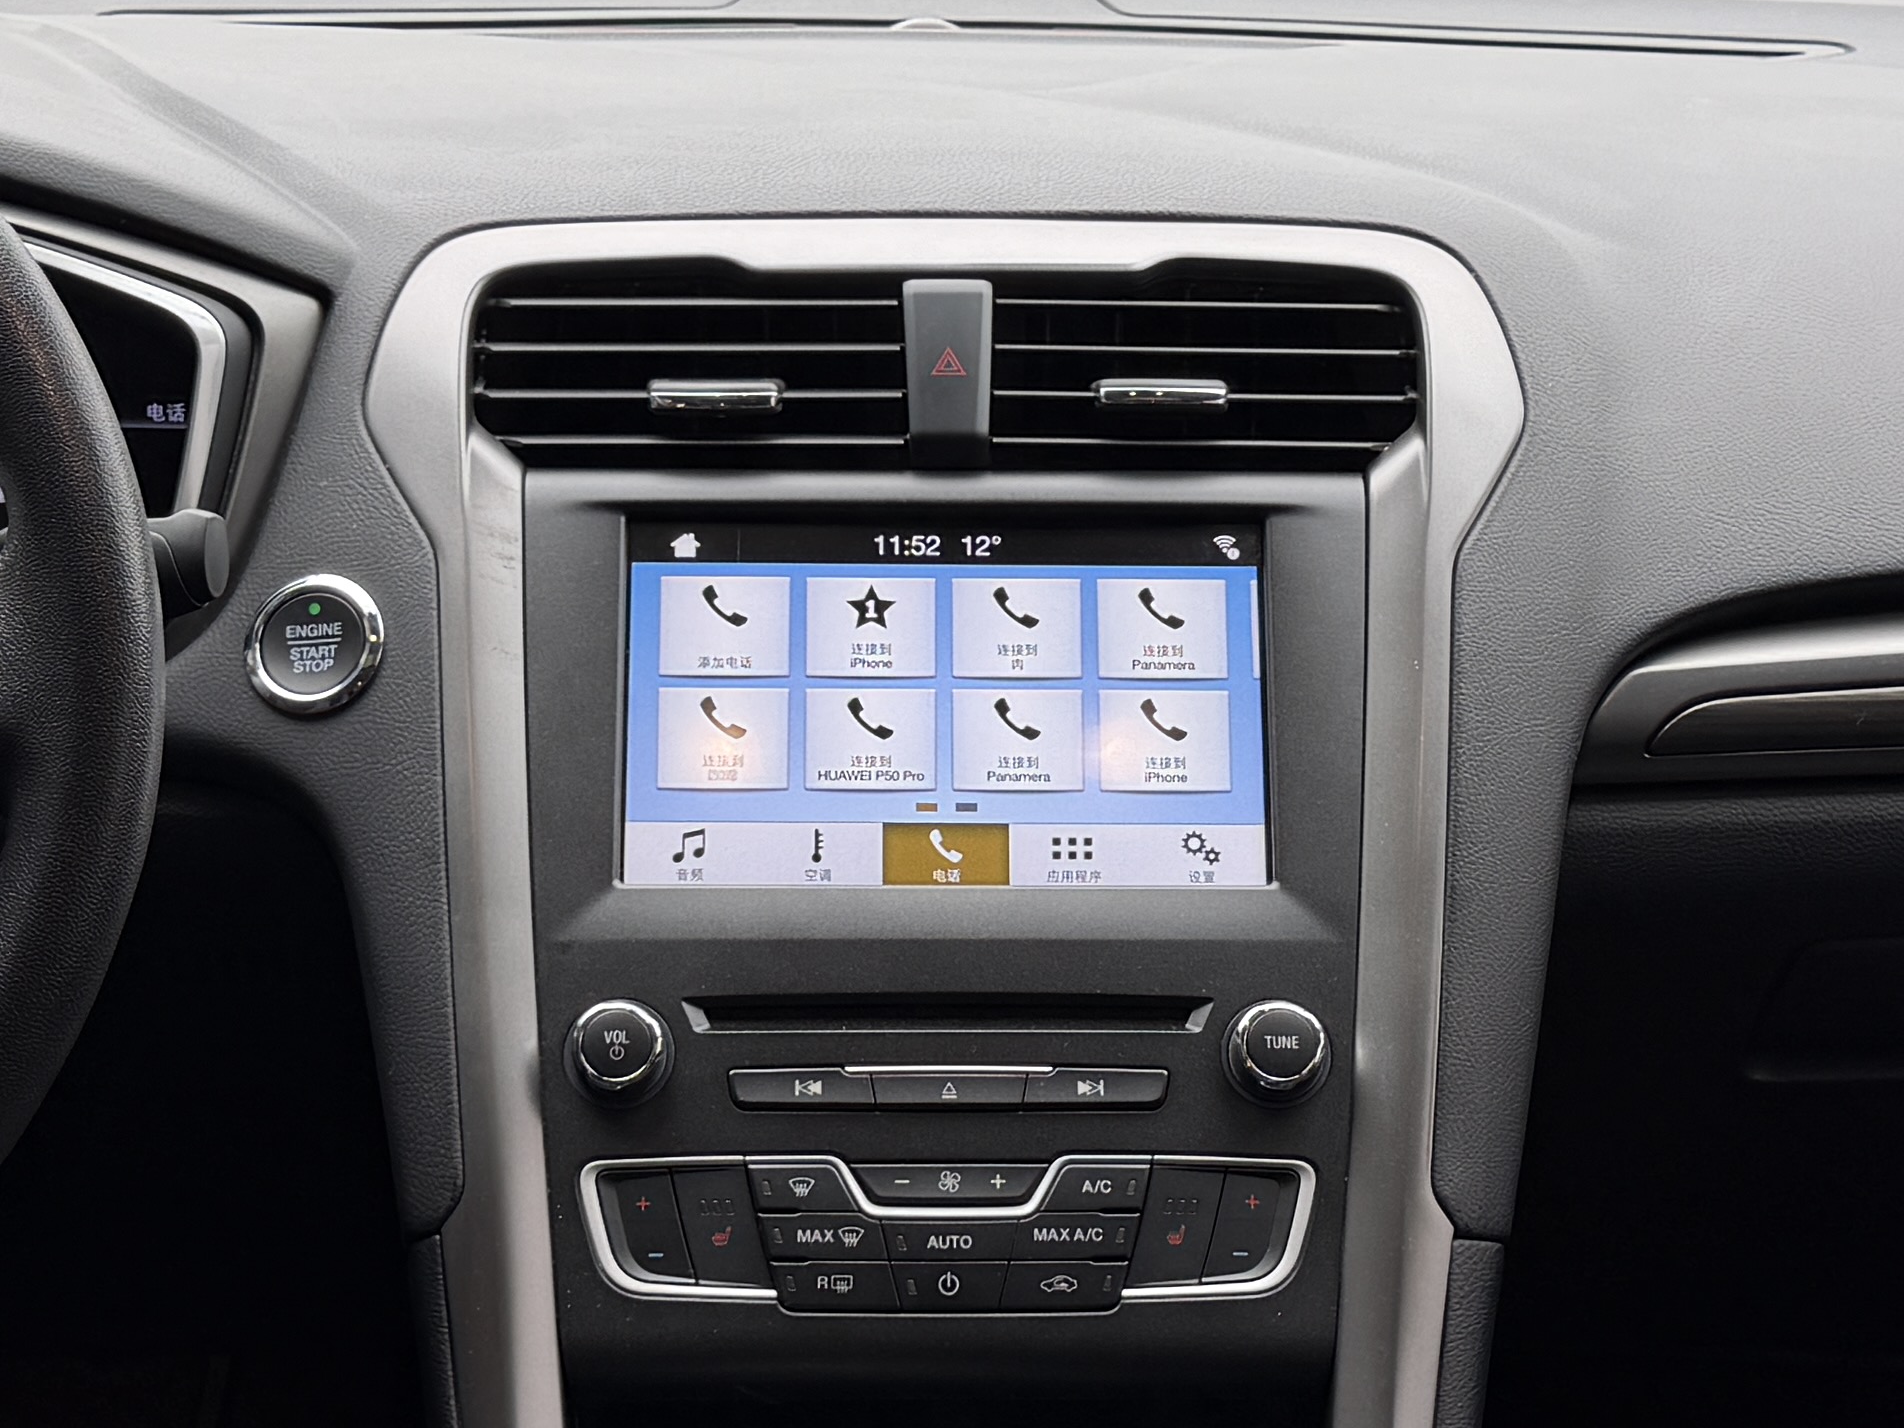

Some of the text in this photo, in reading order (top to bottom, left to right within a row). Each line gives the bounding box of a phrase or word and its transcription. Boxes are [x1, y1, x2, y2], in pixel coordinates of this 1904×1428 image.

[147, 402, 187, 423] 电话
[873, 534, 1003, 558] 11:52 12°
[285, 621, 343, 640] ENGINE
[289, 644, 339, 661] START
[850, 642, 893, 657] 连接到
[997, 643, 1039, 658] 连接到
[1142, 644, 1184, 659] 连接到
[292, 656, 335, 674] STOP
[697, 655, 753, 670] 添加电话
[849, 657, 893, 670] iPhone
[1131, 659, 1196, 672] Panamera
[850, 754, 893, 769] 连接到
[997, 755, 1040, 770] 连接到
[1144, 755, 1186, 770] 连接到
[817, 770, 925, 783] HUAWEI P50 Pro
[986, 770, 1051, 784] Panamera
[1143, 770, 1188, 784] iPhone
[676, 868, 704, 883] 音频
[804, 868, 832, 883] 空调
[933, 868, 961, 883] 电话
[1046, 869, 1102, 884] 应用程序
[1189, 870, 1216, 884] 设置
[603, 1030, 631, 1045] VOL
[1264, 1035, 1301, 1050] TUNE
[1082, 1179, 1112, 1196] A/C
[796, 1229, 834, 1245] MAX
[1032, 1227, 1104, 1243] MAX A/C
[926, 1235, 973, 1251] AUTO
[817, 1276, 829, 1291] R
